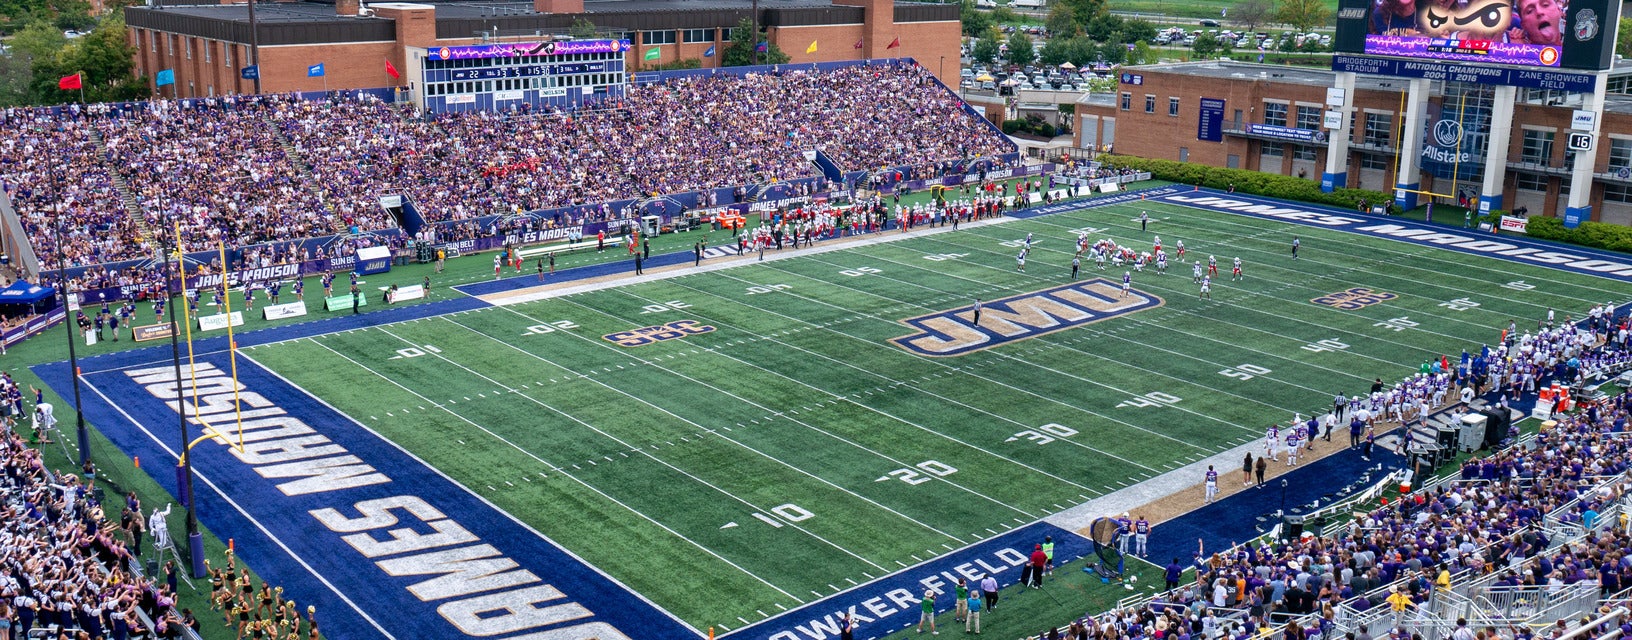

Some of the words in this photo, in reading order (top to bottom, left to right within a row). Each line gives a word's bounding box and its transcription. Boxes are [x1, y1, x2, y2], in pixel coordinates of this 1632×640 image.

[1338, 7, 1367, 19] JMU
[1337, 56, 1389, 68] BRIDGEFORTH
[1345, 64, 1379, 73] STADIUM
[1404, 62, 1447, 72] NATIONAL
[1448, 66, 1502, 76] CHAMPIONS
[469, 70, 479, 79] 22
[1423, 71, 1446, 79] 2004
[1455, 73, 1477, 82] 2016
[1519, 70, 1541, 80] ZANE
[1543, 73, 1589, 84] SHOWKER
[1540, 80, 1565, 89] FIELD
[1577, 136, 1588, 148] 16
[1421, 145, 1469, 164] Allstate
[749, 199, 776, 212] JAMES
[1165, 196, 1368, 226] JAMES
[446, 242, 460, 250] SUN
[460, 239, 475, 248] BELT
[331, 257, 346, 266] SUN
[365, 261, 386, 271] JMU
[194, 272, 239, 288] JAMES
[242, 263, 299, 281] MADISON
[890, 277, 1164, 357] JMU
[1218, 363, 1273, 380] 50
[1118, 391, 1183, 408] 40
[123, 361, 393, 497] MADISON
[1013, 423, 1080, 446] 30
[888, 459, 959, 485] 20
[751, 503, 816, 528] 10
[918, 547, 1029, 596] FIELD
